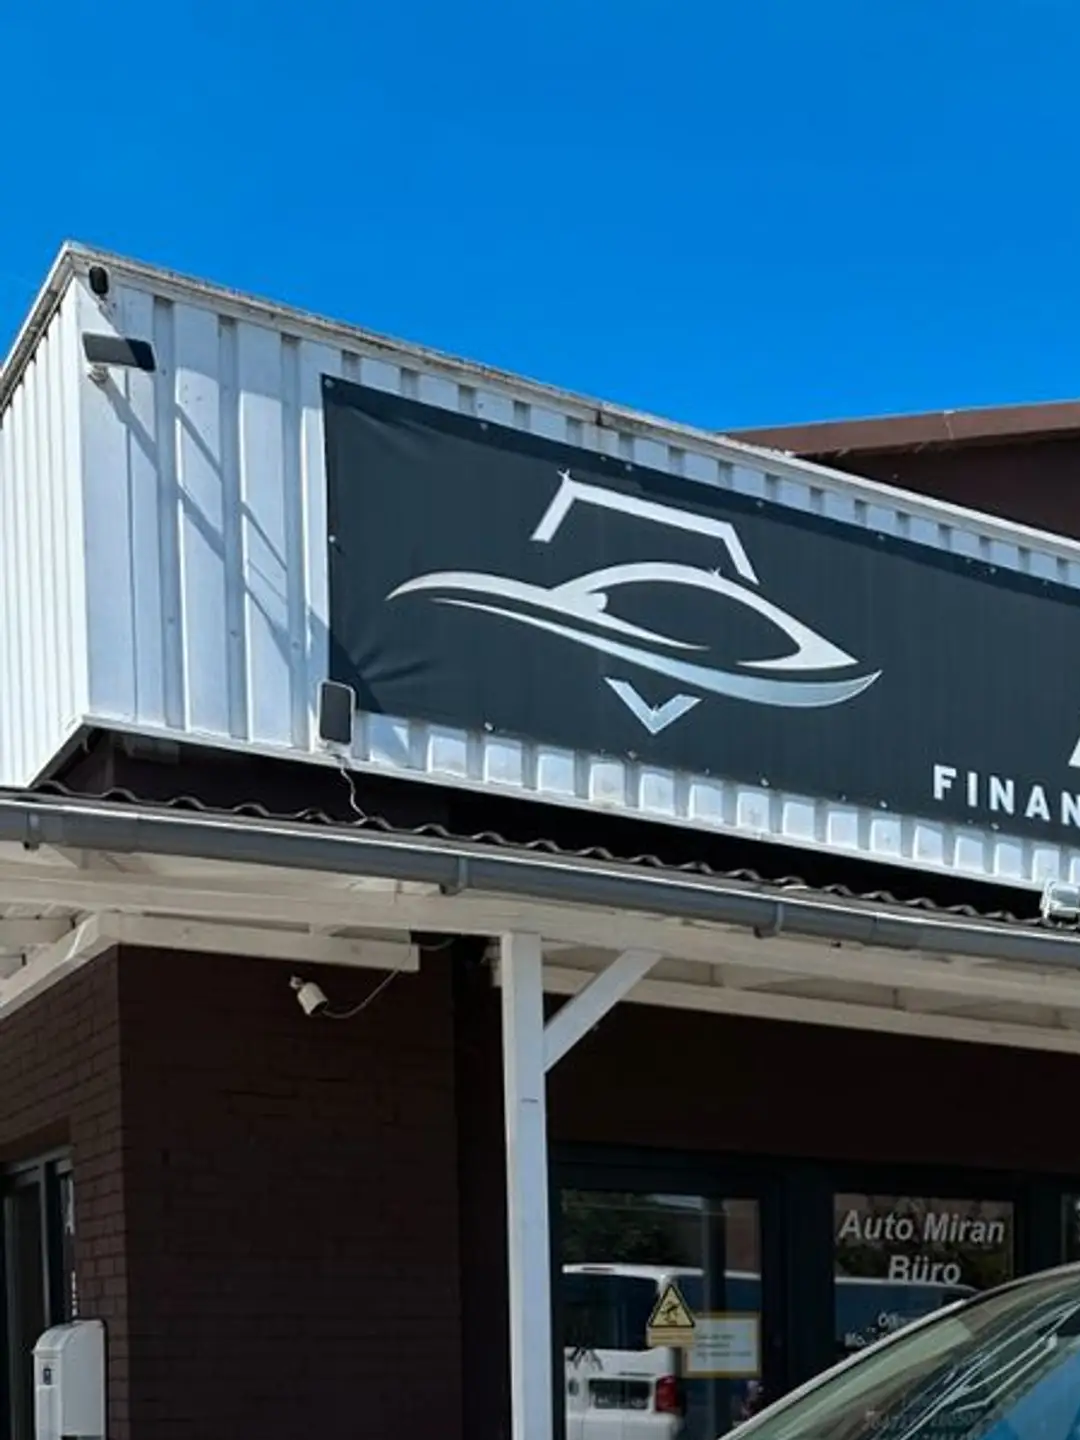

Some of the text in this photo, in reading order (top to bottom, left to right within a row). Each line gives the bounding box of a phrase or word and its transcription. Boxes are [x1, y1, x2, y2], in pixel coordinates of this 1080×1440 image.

[838, 1209, 1005, 1244] Auto Miran
[887, 1253, 962, 1286] Büro
